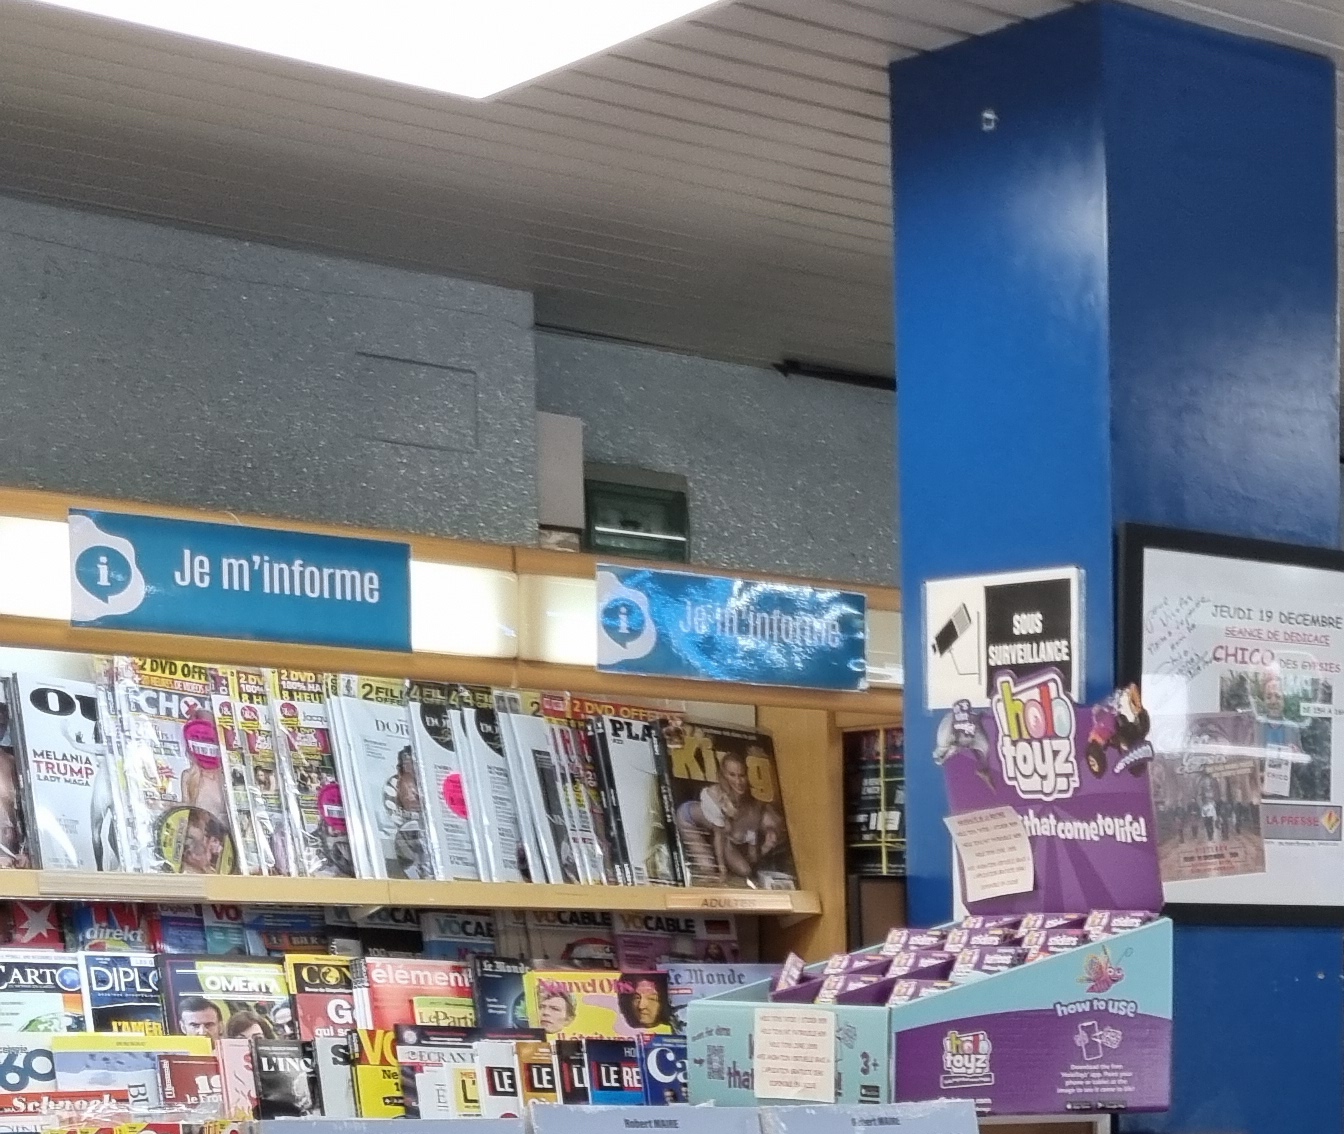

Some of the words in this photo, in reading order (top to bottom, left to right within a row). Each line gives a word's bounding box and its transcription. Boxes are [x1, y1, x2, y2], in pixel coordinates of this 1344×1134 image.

[175, 548, 211, 589] Je
[222, 555, 380, 604] m'informe
[1012, 613, 1042, 634] SOUS
[1212, 604, 1253, 620] JEUDI
[1260, 610, 1273, 622] 19
[1279, 612, 1343, 629] DECEMBRE
[989, 641, 1070, 665] SURVEILLANCE
[1213, 645, 1274, 666] CHICO
[33, 749, 92, 765] MELANIA
[1002, 739, 1075, 793] toyz
[33, 760, 94, 779] TRUMP
[1266, 815, 1278, 826] LA
[1280, 815, 1320, 828] PRESSE
[84, 924, 145, 942] direkt
[205, 976, 280, 992] OMERTA
[686, 968, 746, 985] Monde
[1056, 1001, 1090, 1016] how
[1093, 1000, 1106, 1010] to
[1108, 1000, 1135, 1017] use
